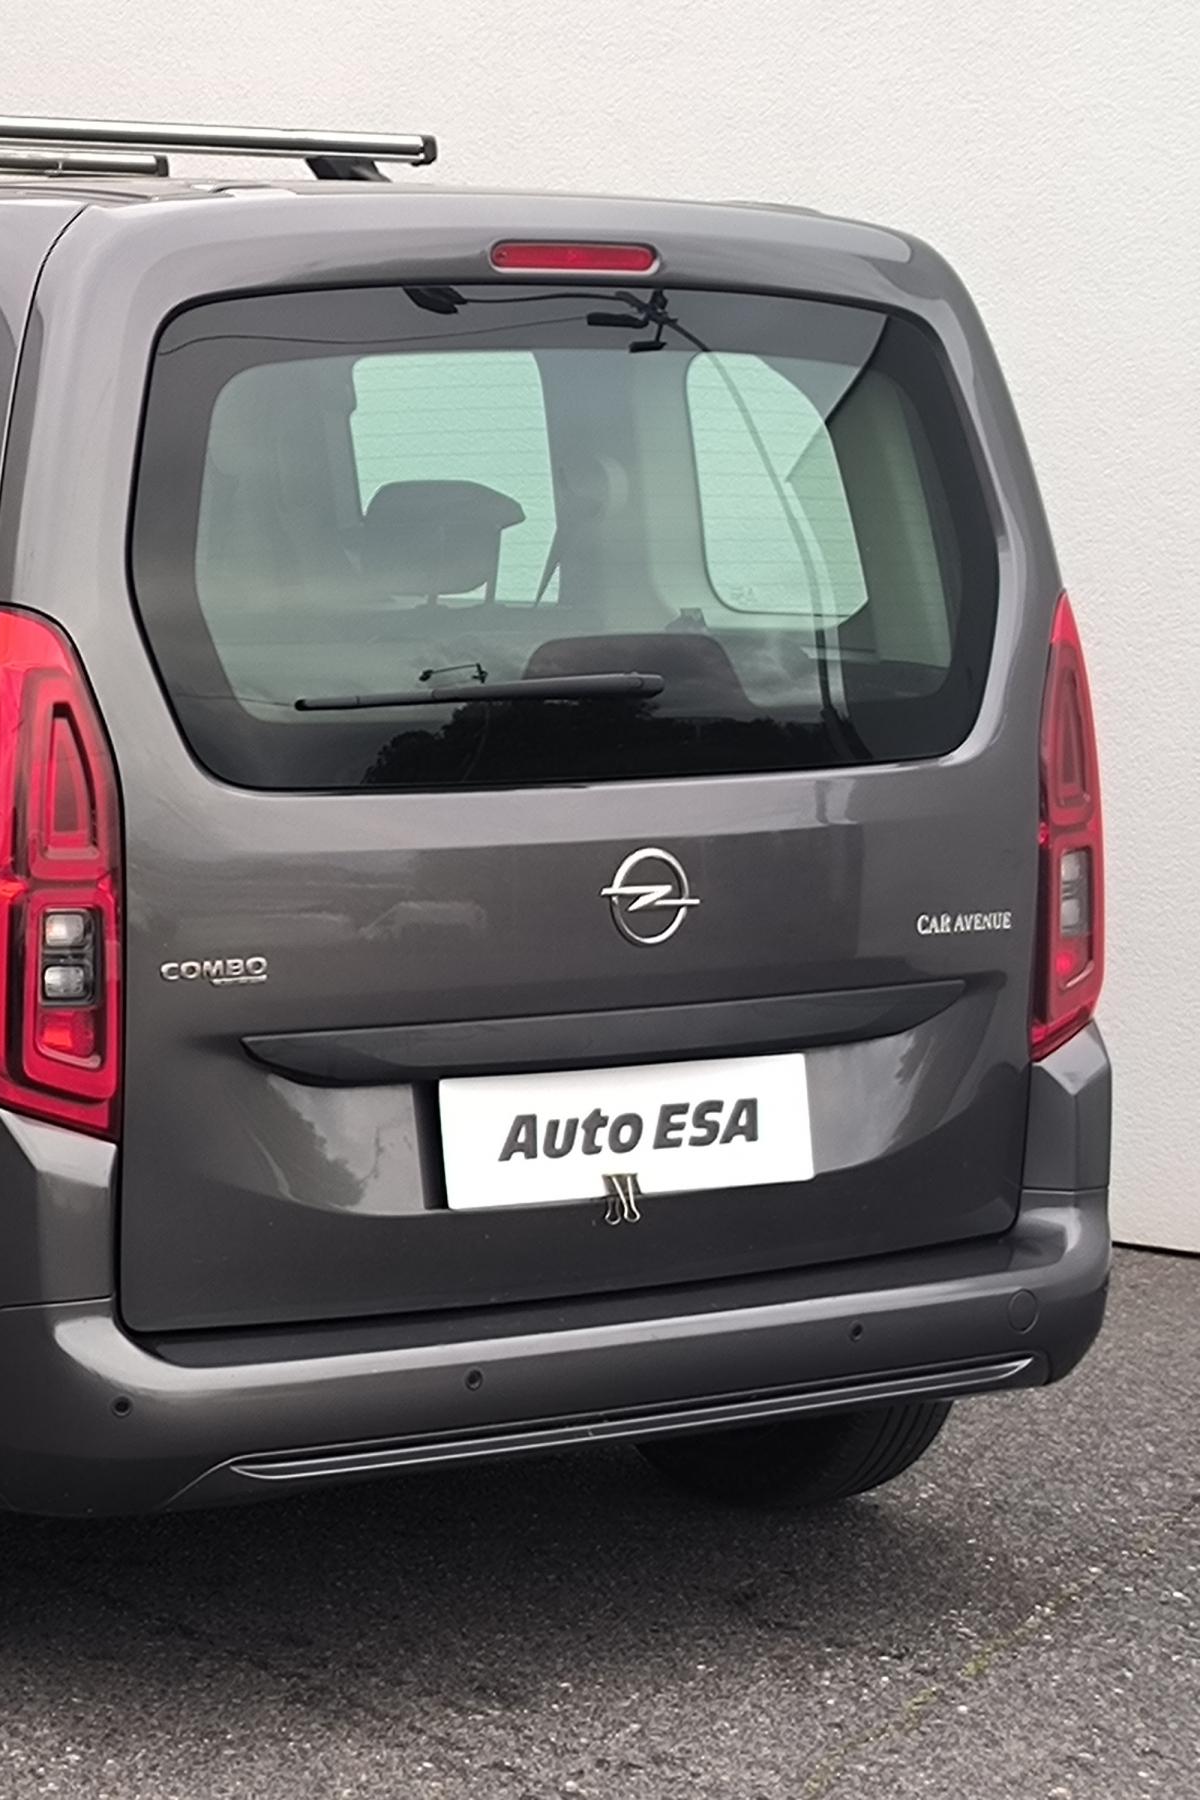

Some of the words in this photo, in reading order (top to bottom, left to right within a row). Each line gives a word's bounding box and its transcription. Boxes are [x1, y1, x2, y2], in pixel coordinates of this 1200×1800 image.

[916, 912, 951, 936] CAR
[953, 910, 1012, 933] AVENUE
[160, 956, 268, 982] COMBO
[498, 1108, 643, 1162] Auto
[652, 1097, 759, 1150] ESA
